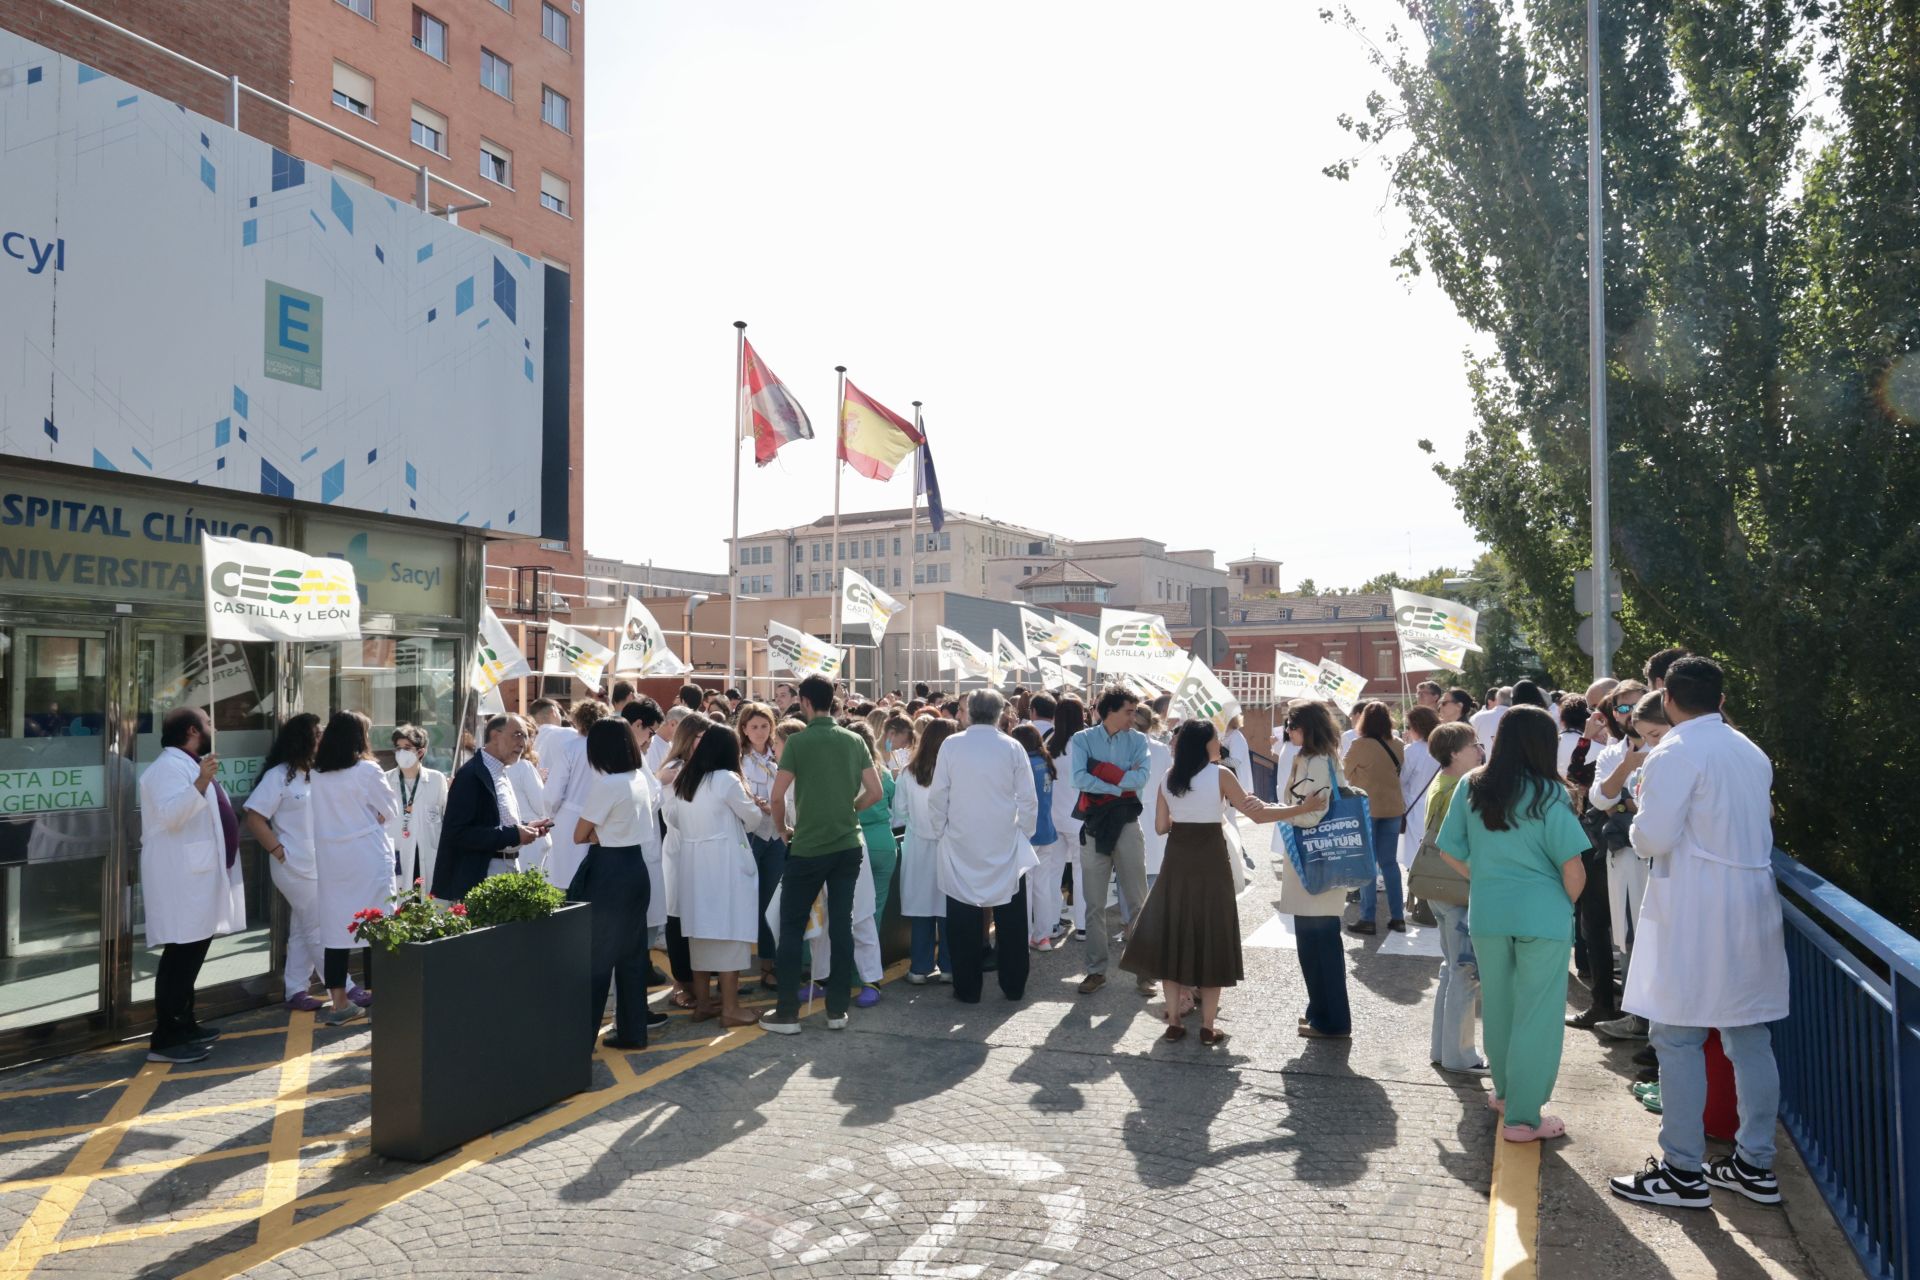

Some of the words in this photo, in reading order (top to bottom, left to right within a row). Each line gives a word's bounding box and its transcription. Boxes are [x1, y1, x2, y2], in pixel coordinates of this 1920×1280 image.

[279, 294, 310, 353] E
[0, 547, 204, 594] NIVERSITA
[391, 561, 441, 591] Sacyl
[213, 601, 290, 621] CASTILLA
[307, 607, 351, 621] LEÓN
[1104, 649, 1145, 658] CASTILLA
[233, 759, 257, 774] DE
[52, 769, 83, 787] DE
[0, 790, 94, 812] GENCIA
[1302, 827, 1317, 836] NO
[1318, 819, 1359, 832] COMPRO
